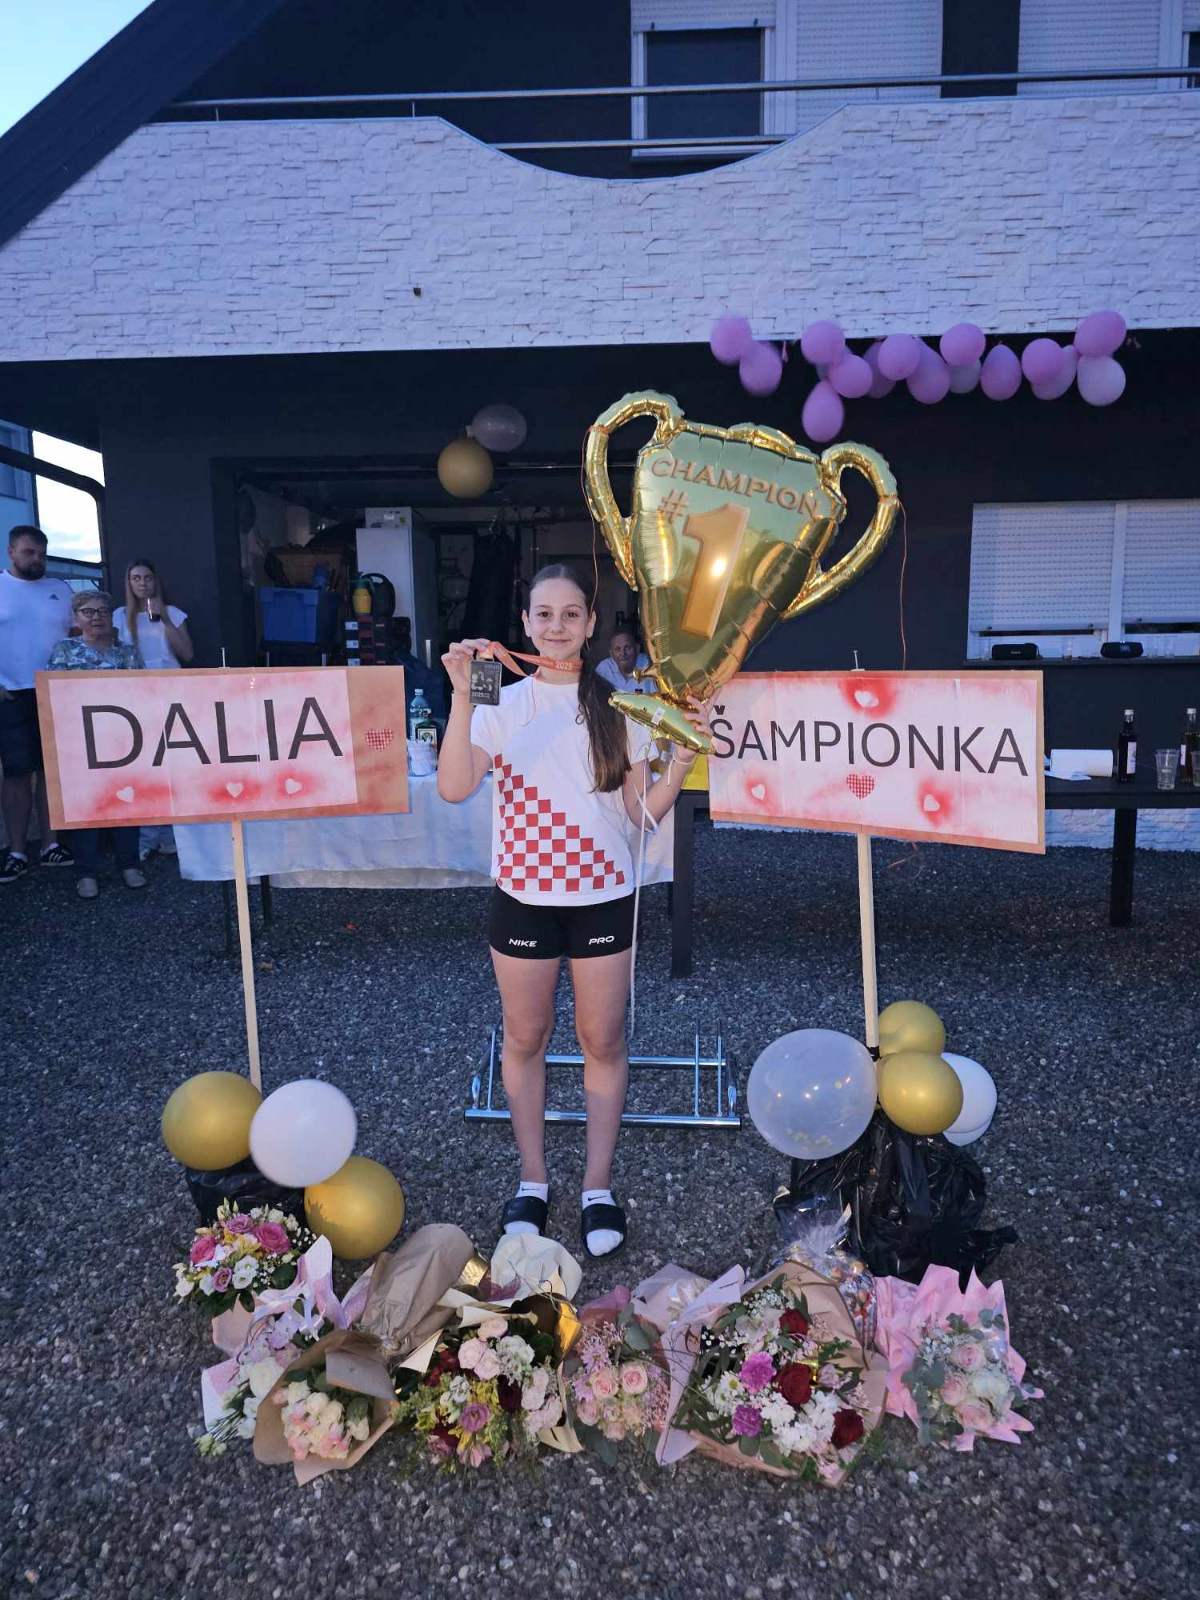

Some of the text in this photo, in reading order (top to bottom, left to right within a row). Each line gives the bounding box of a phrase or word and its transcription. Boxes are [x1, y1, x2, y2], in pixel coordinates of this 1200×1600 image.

[651, 459, 818, 516] CHAMPION
[81, 697, 343, 769] DALIA
[710, 705, 1028, 777] ŠAMPIONKA
[508, 935, 615, 948] NIKE PRO
